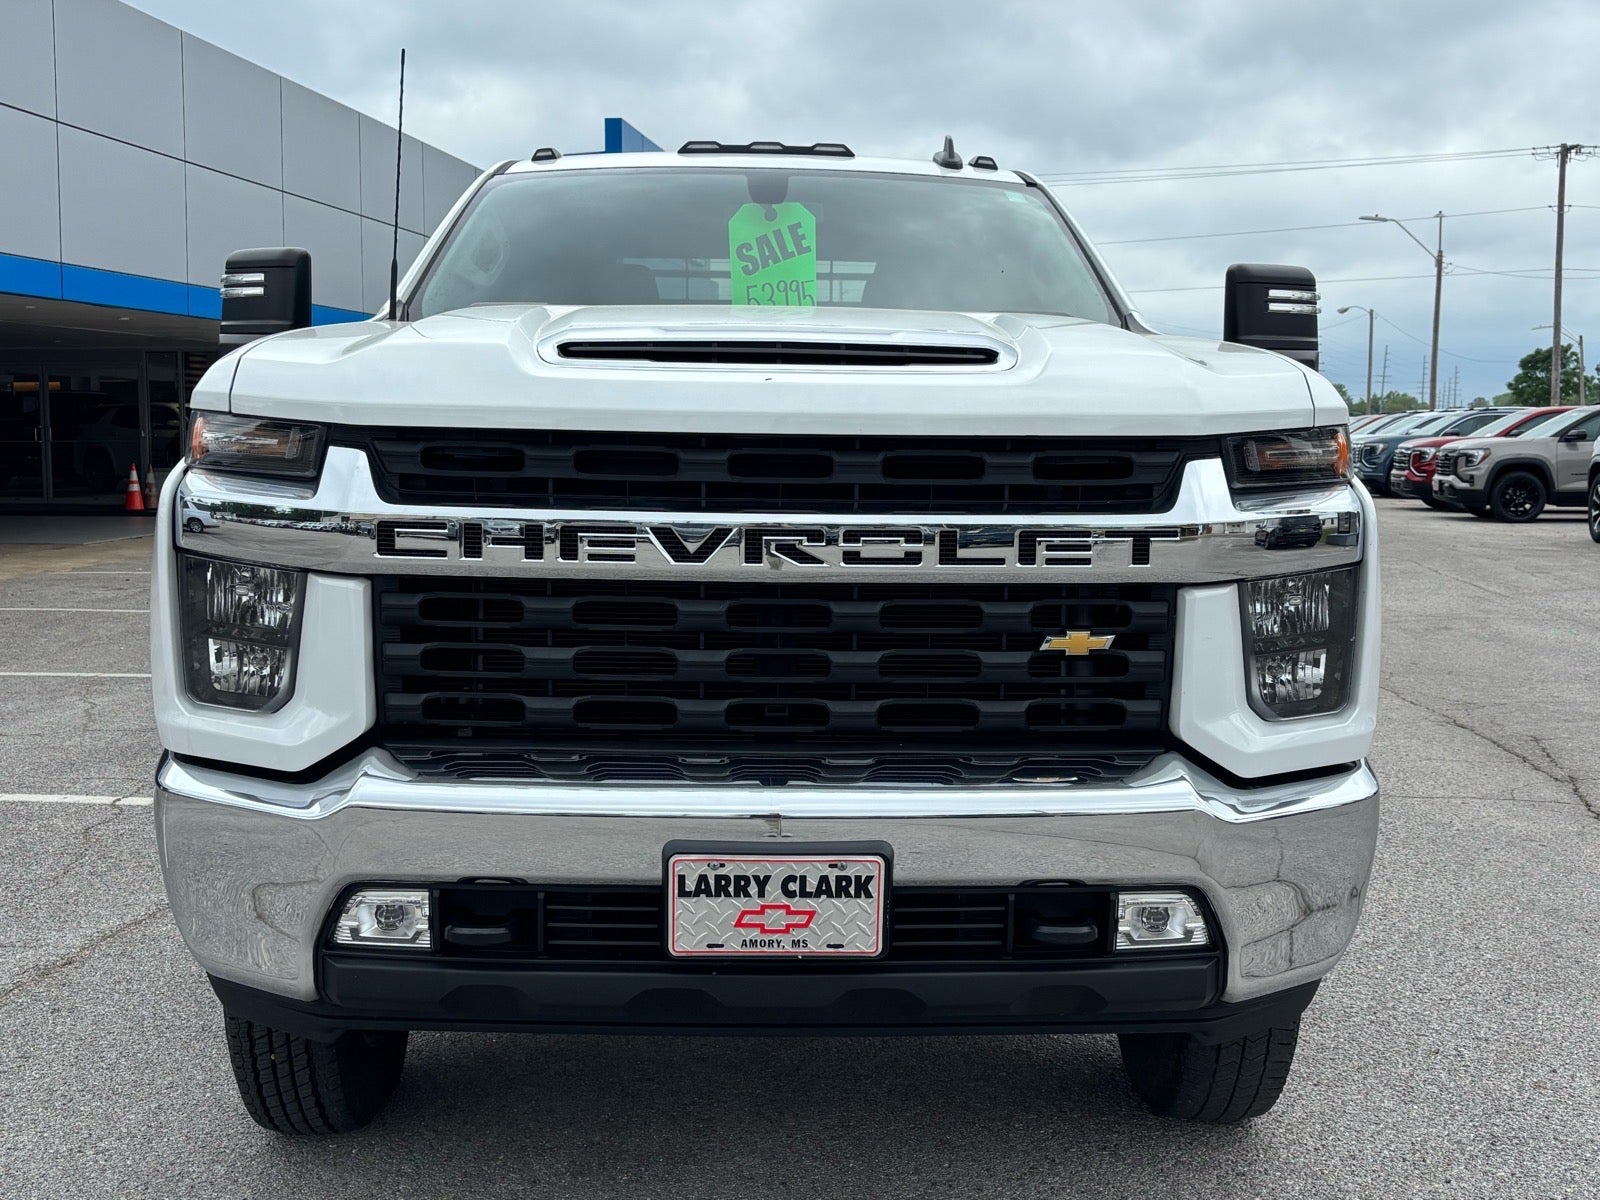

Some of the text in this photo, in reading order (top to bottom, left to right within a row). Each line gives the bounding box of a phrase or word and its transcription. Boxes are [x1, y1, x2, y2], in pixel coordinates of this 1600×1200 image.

[735, 221, 812, 276] SALE
[374, 518, 1181, 566] CHEVROLET
[677, 874, 875, 898] LARRY CLARK
[740, 938, 809, 950] AMORY, MS
